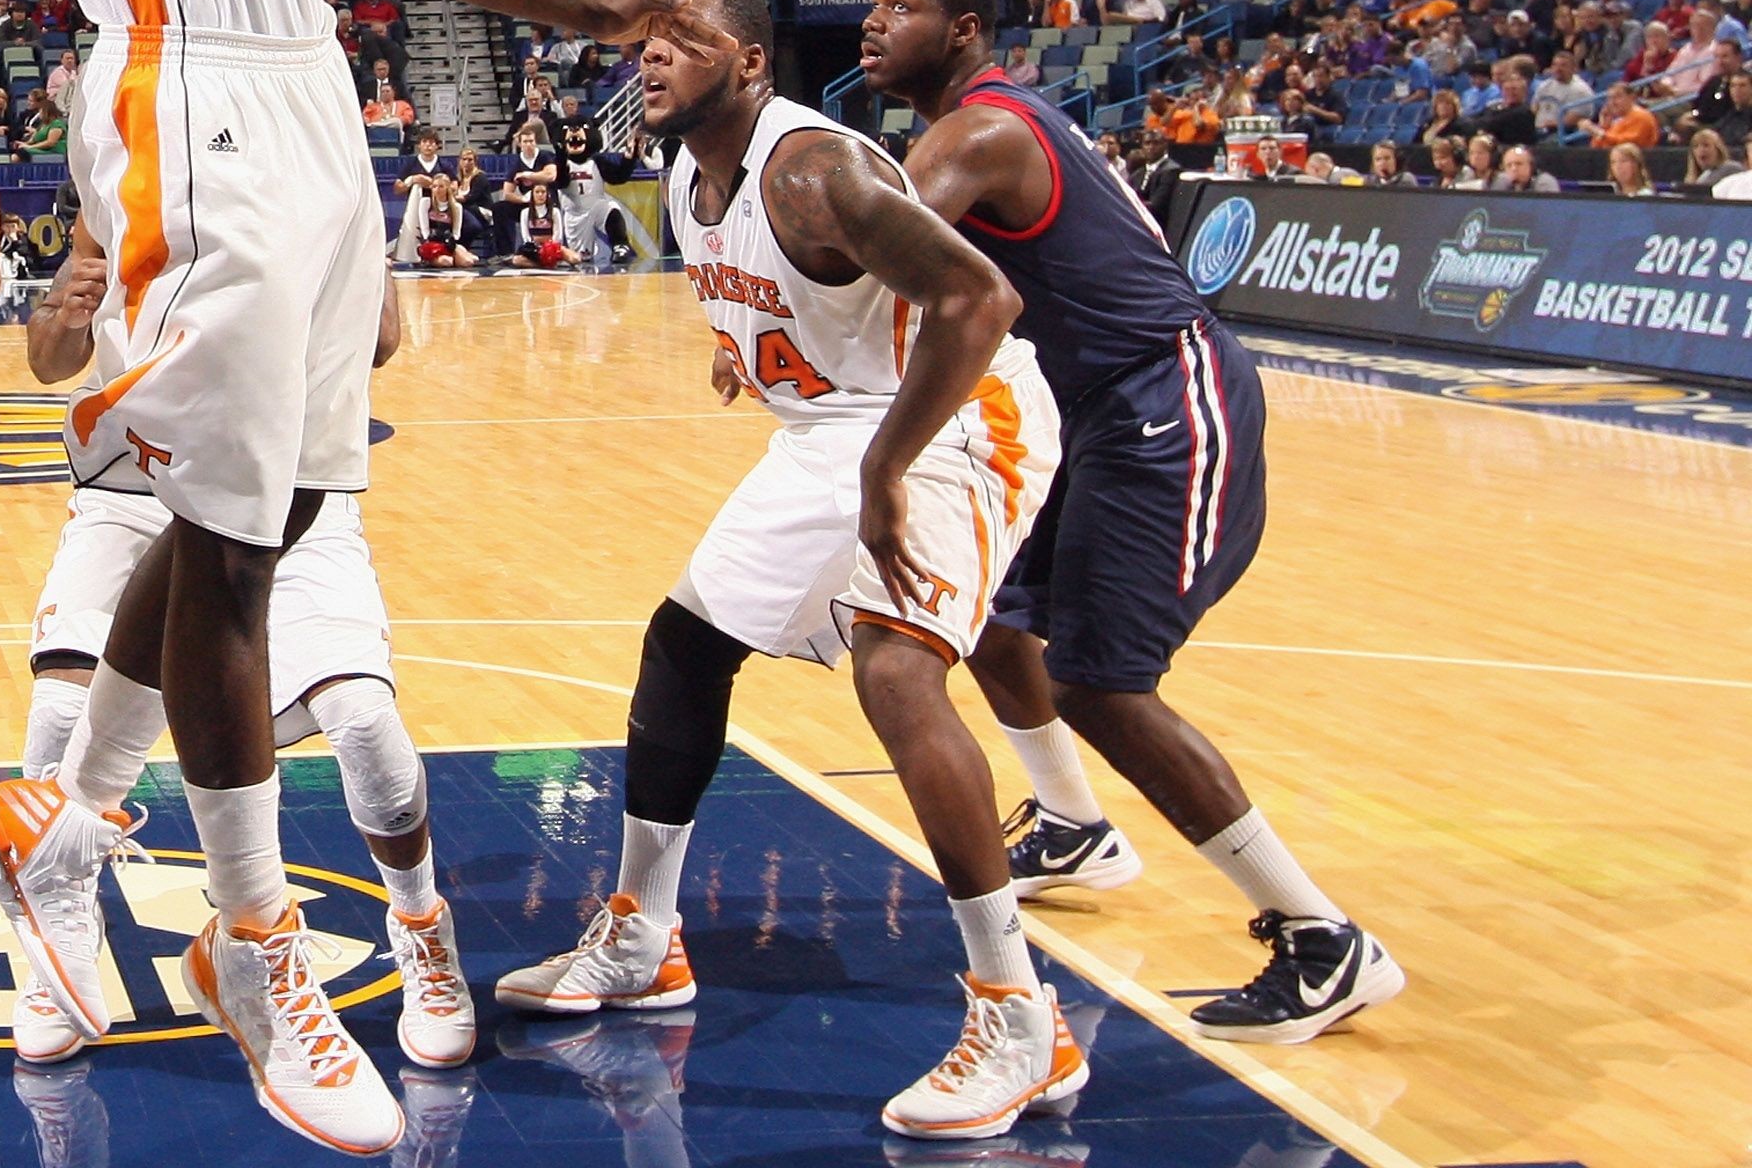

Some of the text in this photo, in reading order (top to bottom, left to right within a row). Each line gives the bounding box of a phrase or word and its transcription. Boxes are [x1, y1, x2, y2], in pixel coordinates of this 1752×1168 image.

[207, 143, 239, 153] adidas
[1238, 220, 1401, 302] Allstate
[1424, 246, 1540, 293] TOURNAMENT
[1637, 234, 1717, 278] 2012
[1535, 278, 1729, 337] BASKETBALL
